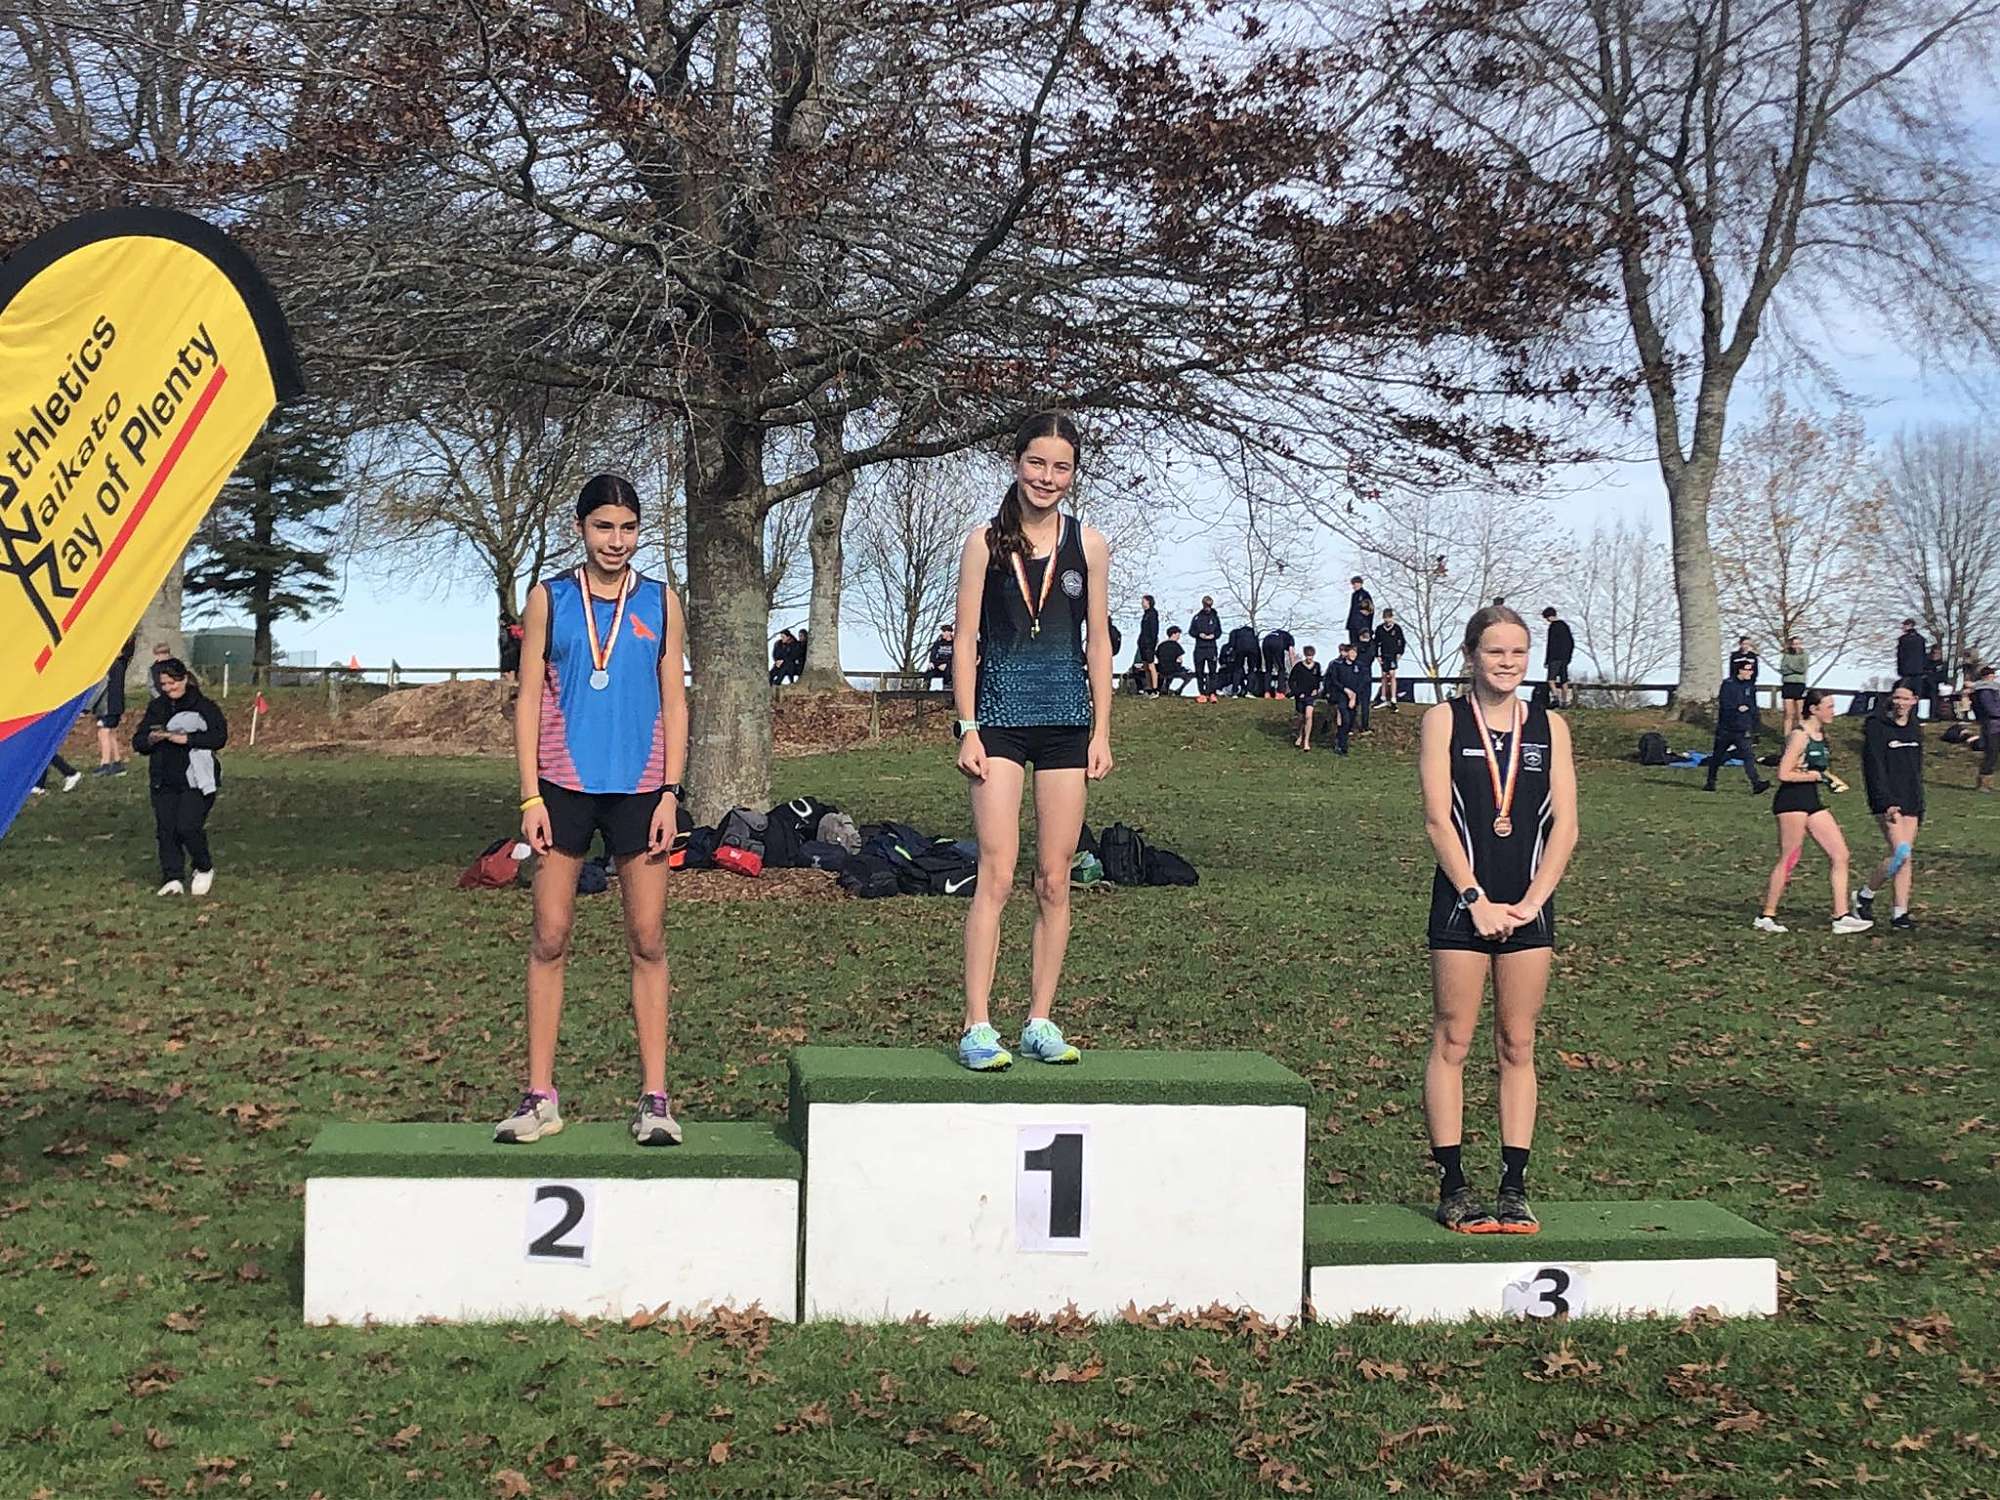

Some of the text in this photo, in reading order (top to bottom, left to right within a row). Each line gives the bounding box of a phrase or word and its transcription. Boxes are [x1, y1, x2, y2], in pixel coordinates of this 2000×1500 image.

[96, 452, 130, 516] of
[120, 322, 219, 467] Plenty
[527, 1185, 586, 1260] 2
[1024, 1133, 1083, 1238] 1
[1525, 1268, 1571, 1319] 3
